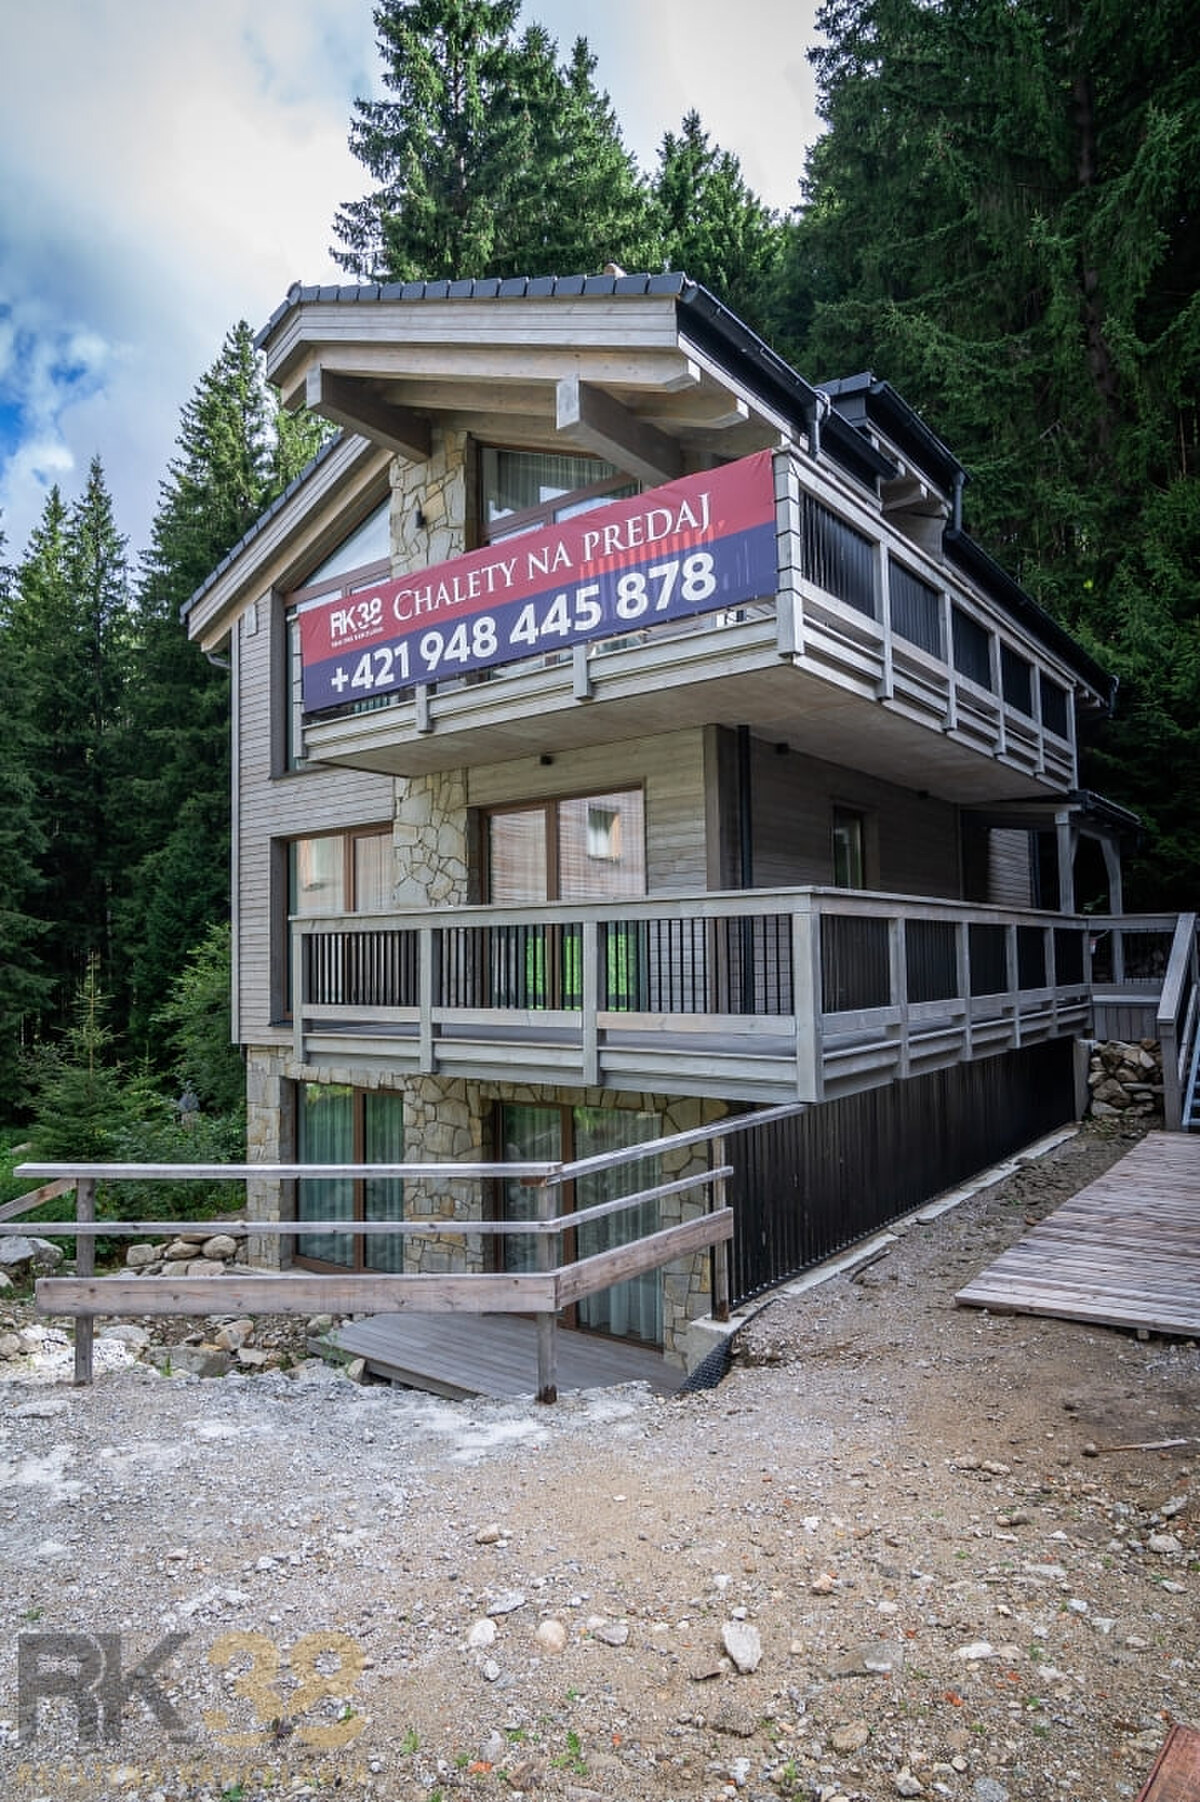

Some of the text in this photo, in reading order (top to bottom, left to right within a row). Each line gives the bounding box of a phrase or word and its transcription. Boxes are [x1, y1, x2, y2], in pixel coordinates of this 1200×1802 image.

[330, 551, 717, 693] +421 948 445 878
[392, 491, 711, 622] CHALETY NA PREDAJ
